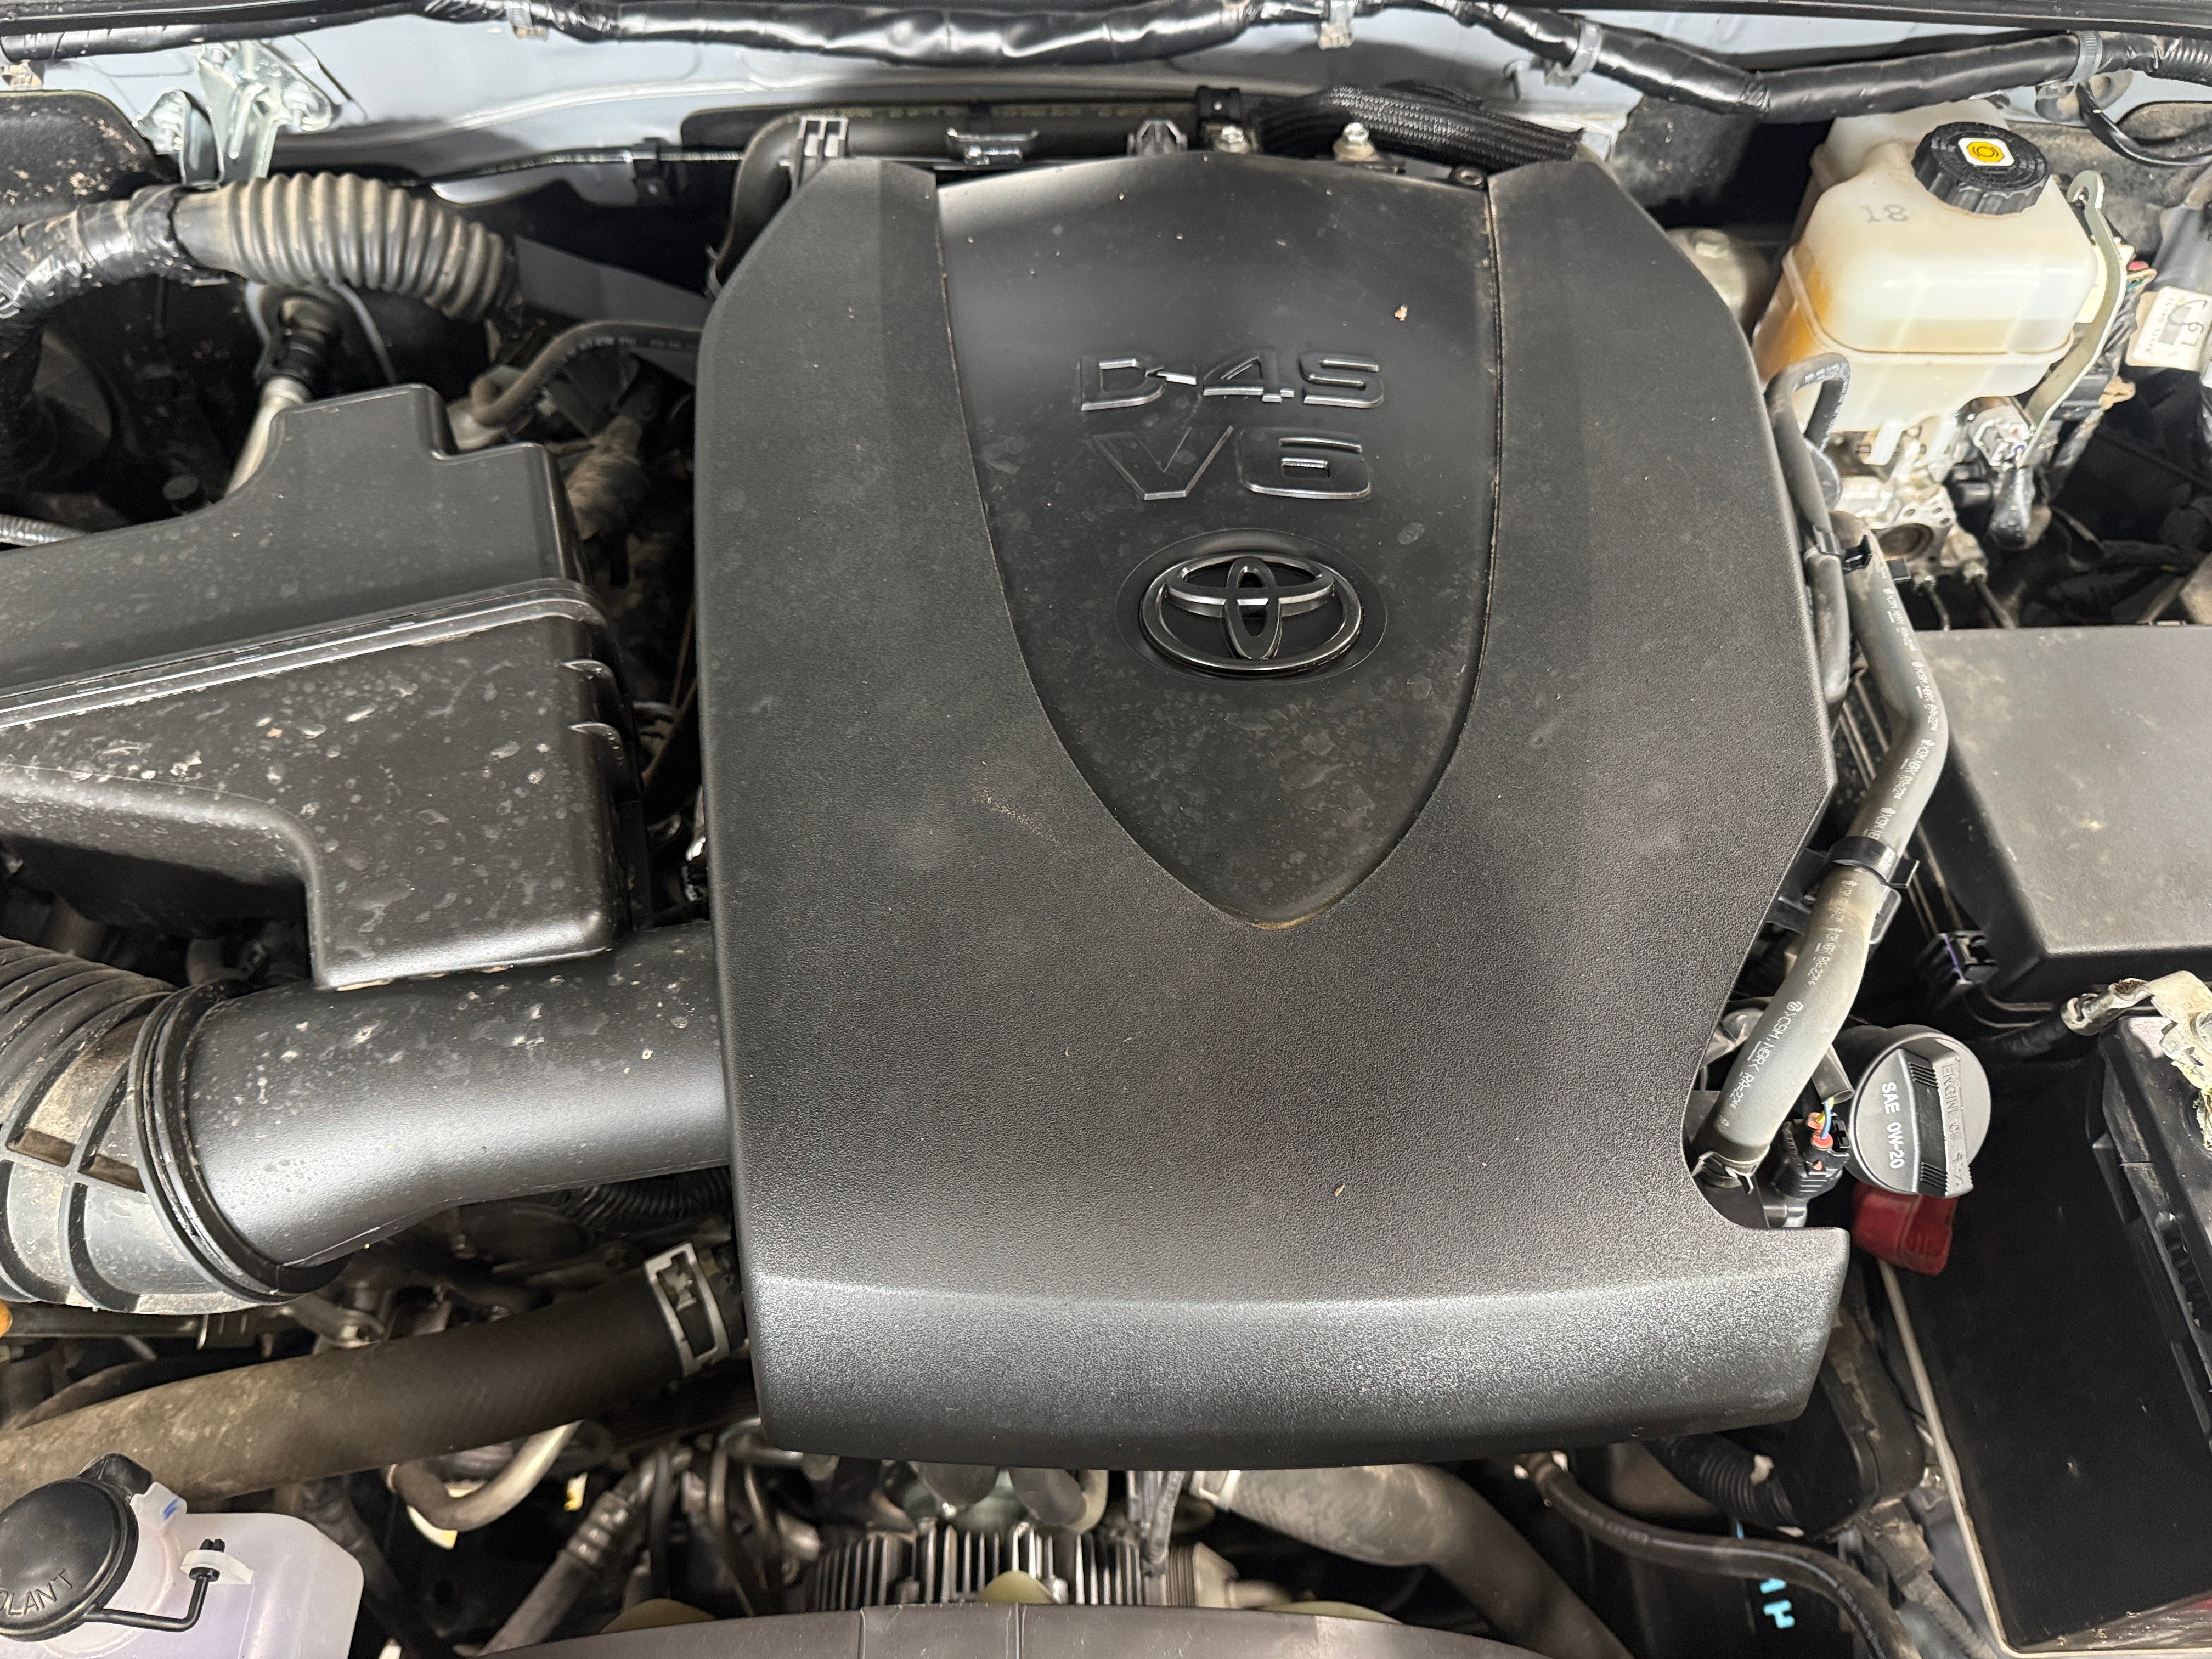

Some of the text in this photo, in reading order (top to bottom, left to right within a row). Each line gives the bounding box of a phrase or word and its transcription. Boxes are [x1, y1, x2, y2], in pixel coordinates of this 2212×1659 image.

[1859, 204, 1910, 223] 18
[1078, 348, 1385, 411] D-4S
[1091, 425, 1371, 501] V6
[1881, 1081, 1905, 1169] SAE 0W-20
[1942, 1063, 1962, 1146] ENGINE OIL
